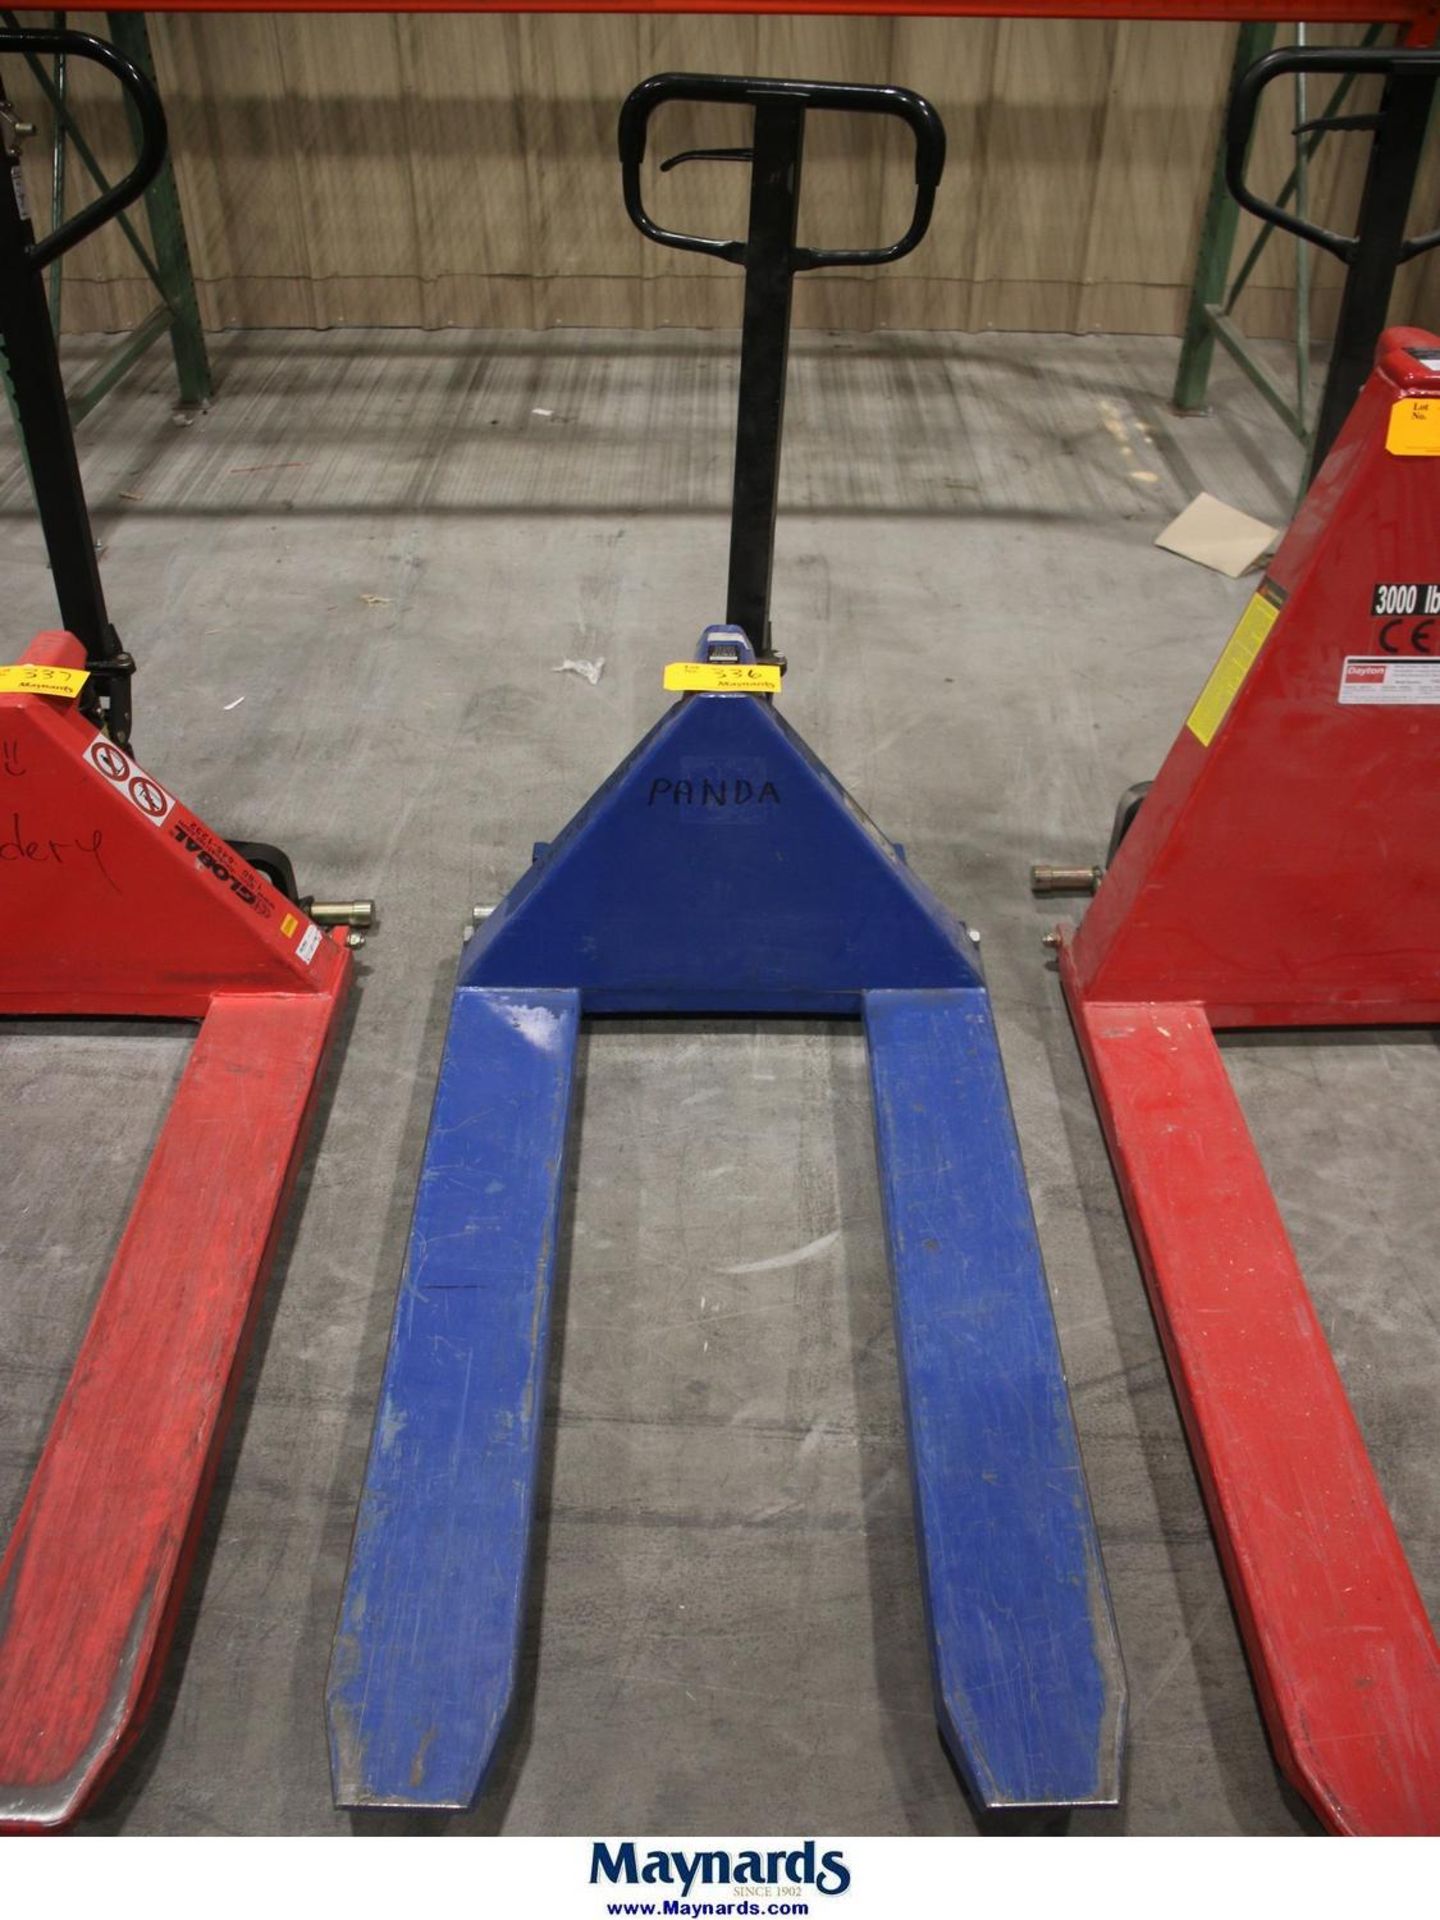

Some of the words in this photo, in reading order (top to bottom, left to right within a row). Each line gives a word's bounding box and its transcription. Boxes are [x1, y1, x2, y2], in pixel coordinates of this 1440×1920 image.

[1375, 585, 1417, 614] 3000
[1379, 619, 1435, 653] CE
[23, 668, 72, 681] 337
[711, 667, 763, 679] 336
[1347, 666, 1385, 677] Dayton
[648, 777, 781, 806] PANDA
[174, 824, 257, 905] GLOBAL
